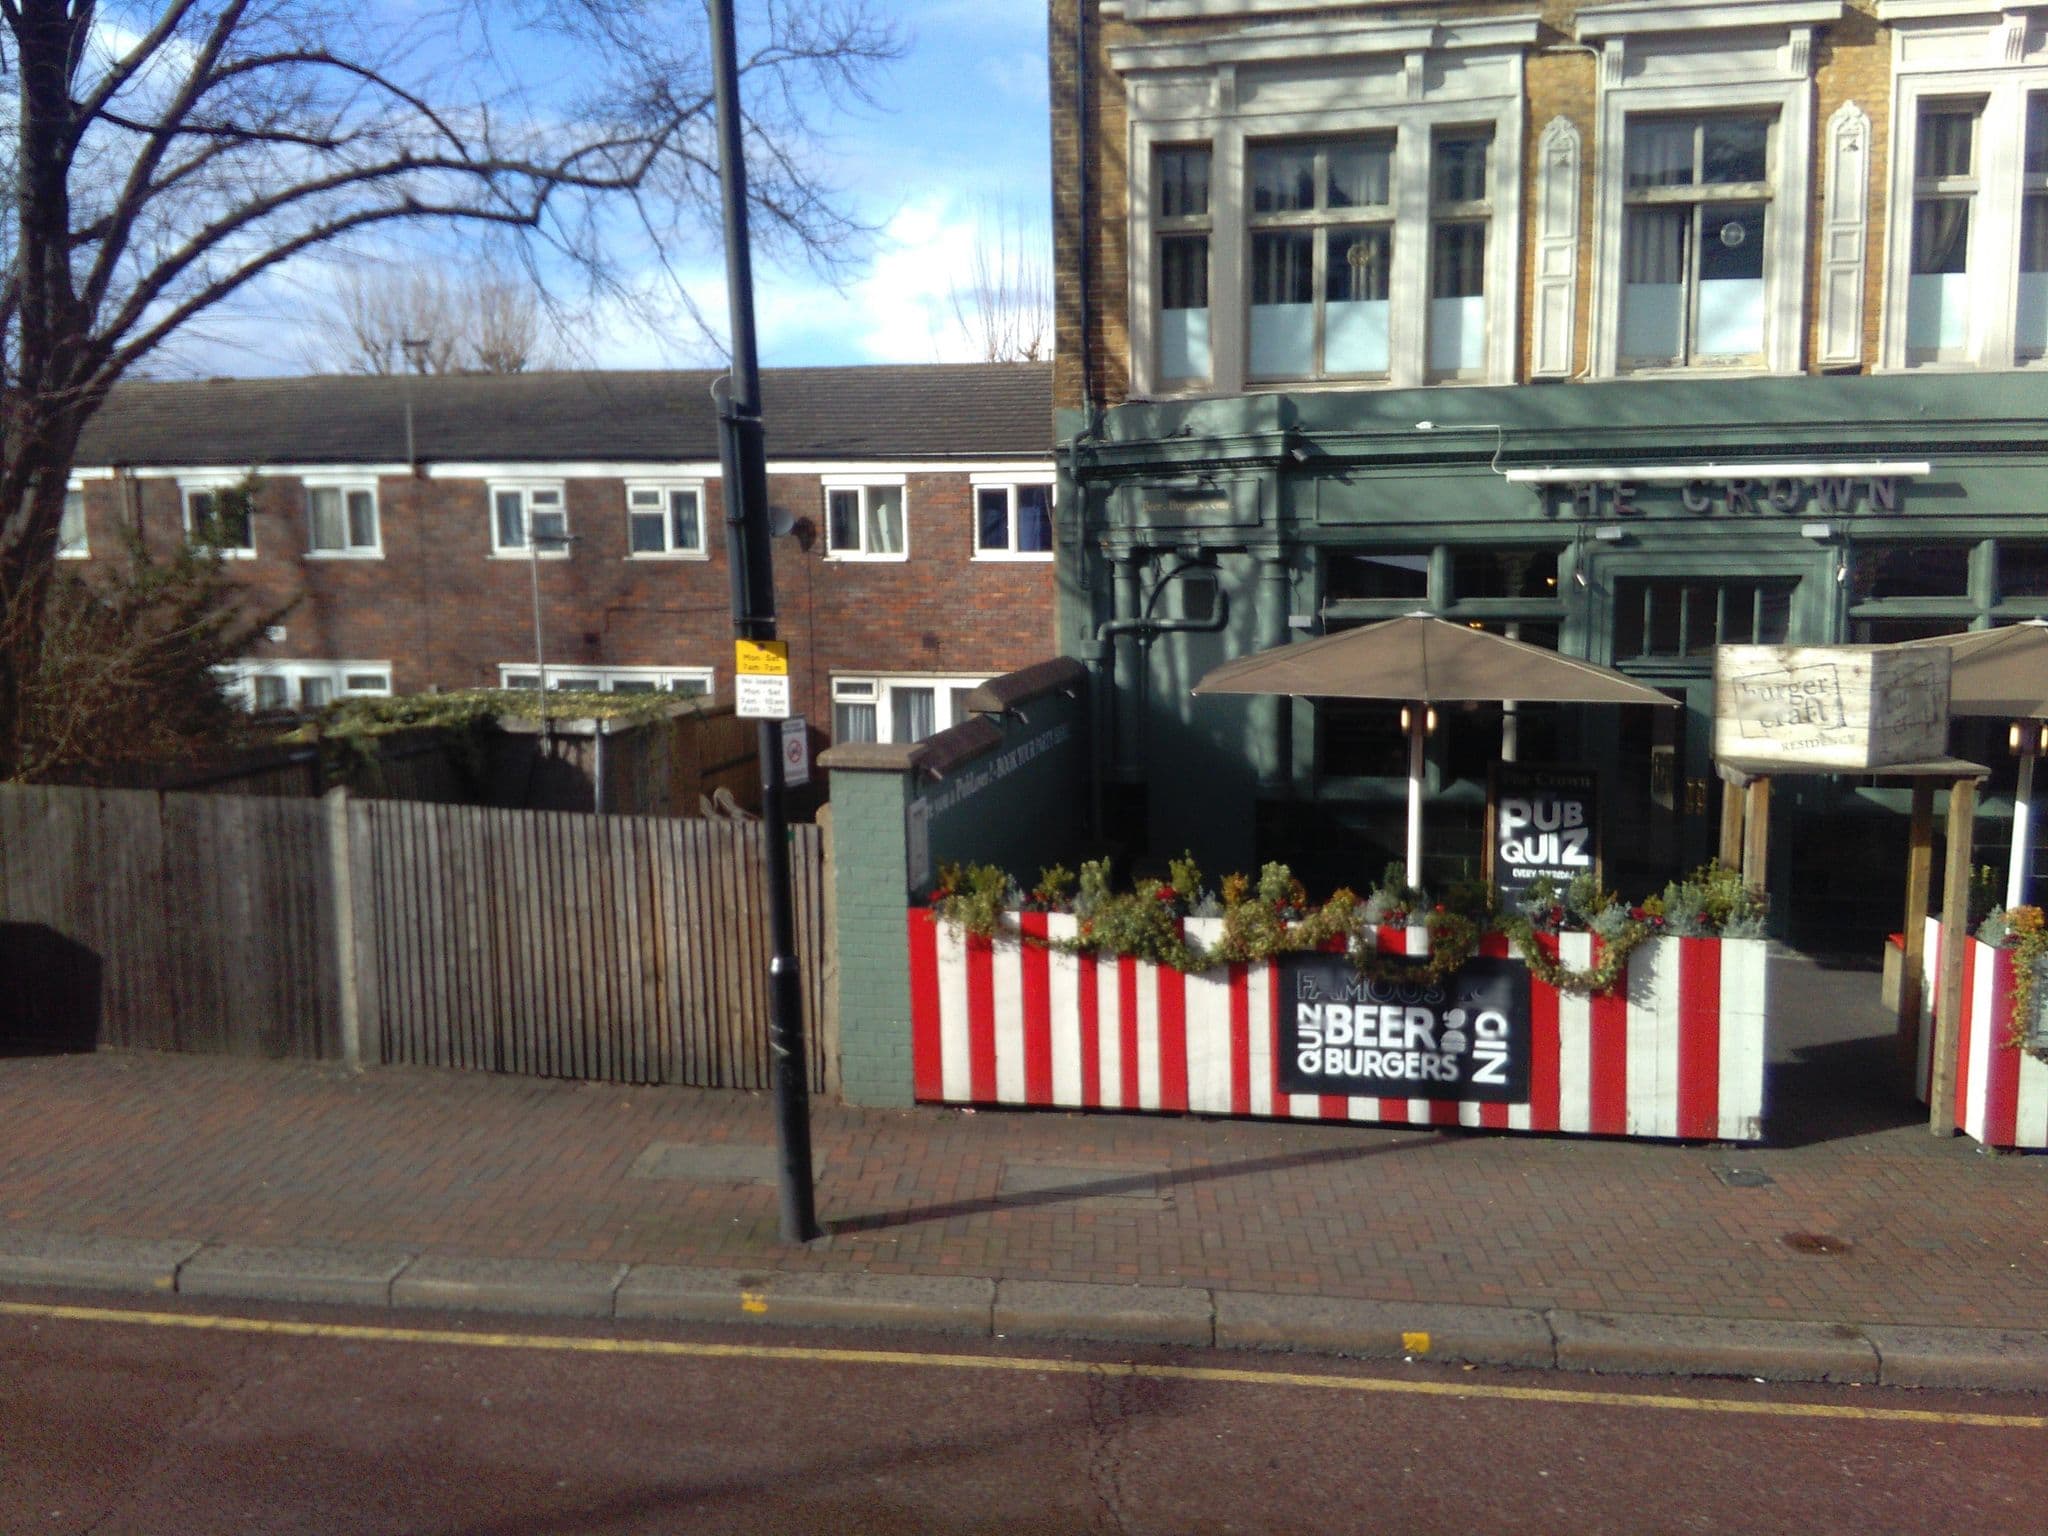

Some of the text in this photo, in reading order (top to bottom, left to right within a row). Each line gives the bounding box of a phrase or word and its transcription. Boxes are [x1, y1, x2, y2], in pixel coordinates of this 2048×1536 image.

[1534, 477, 1899, 515] THE CROWN
[755, 678, 784, 687] loading
[1501, 799, 1584, 838] PUB
[1500, 828, 1589, 866] QUIZ
[1297, 1003, 1322, 1074] QUIZ
[1325, 1004, 1435, 1049] BEER
[1325, 1048, 1459, 1082] BURGERS
